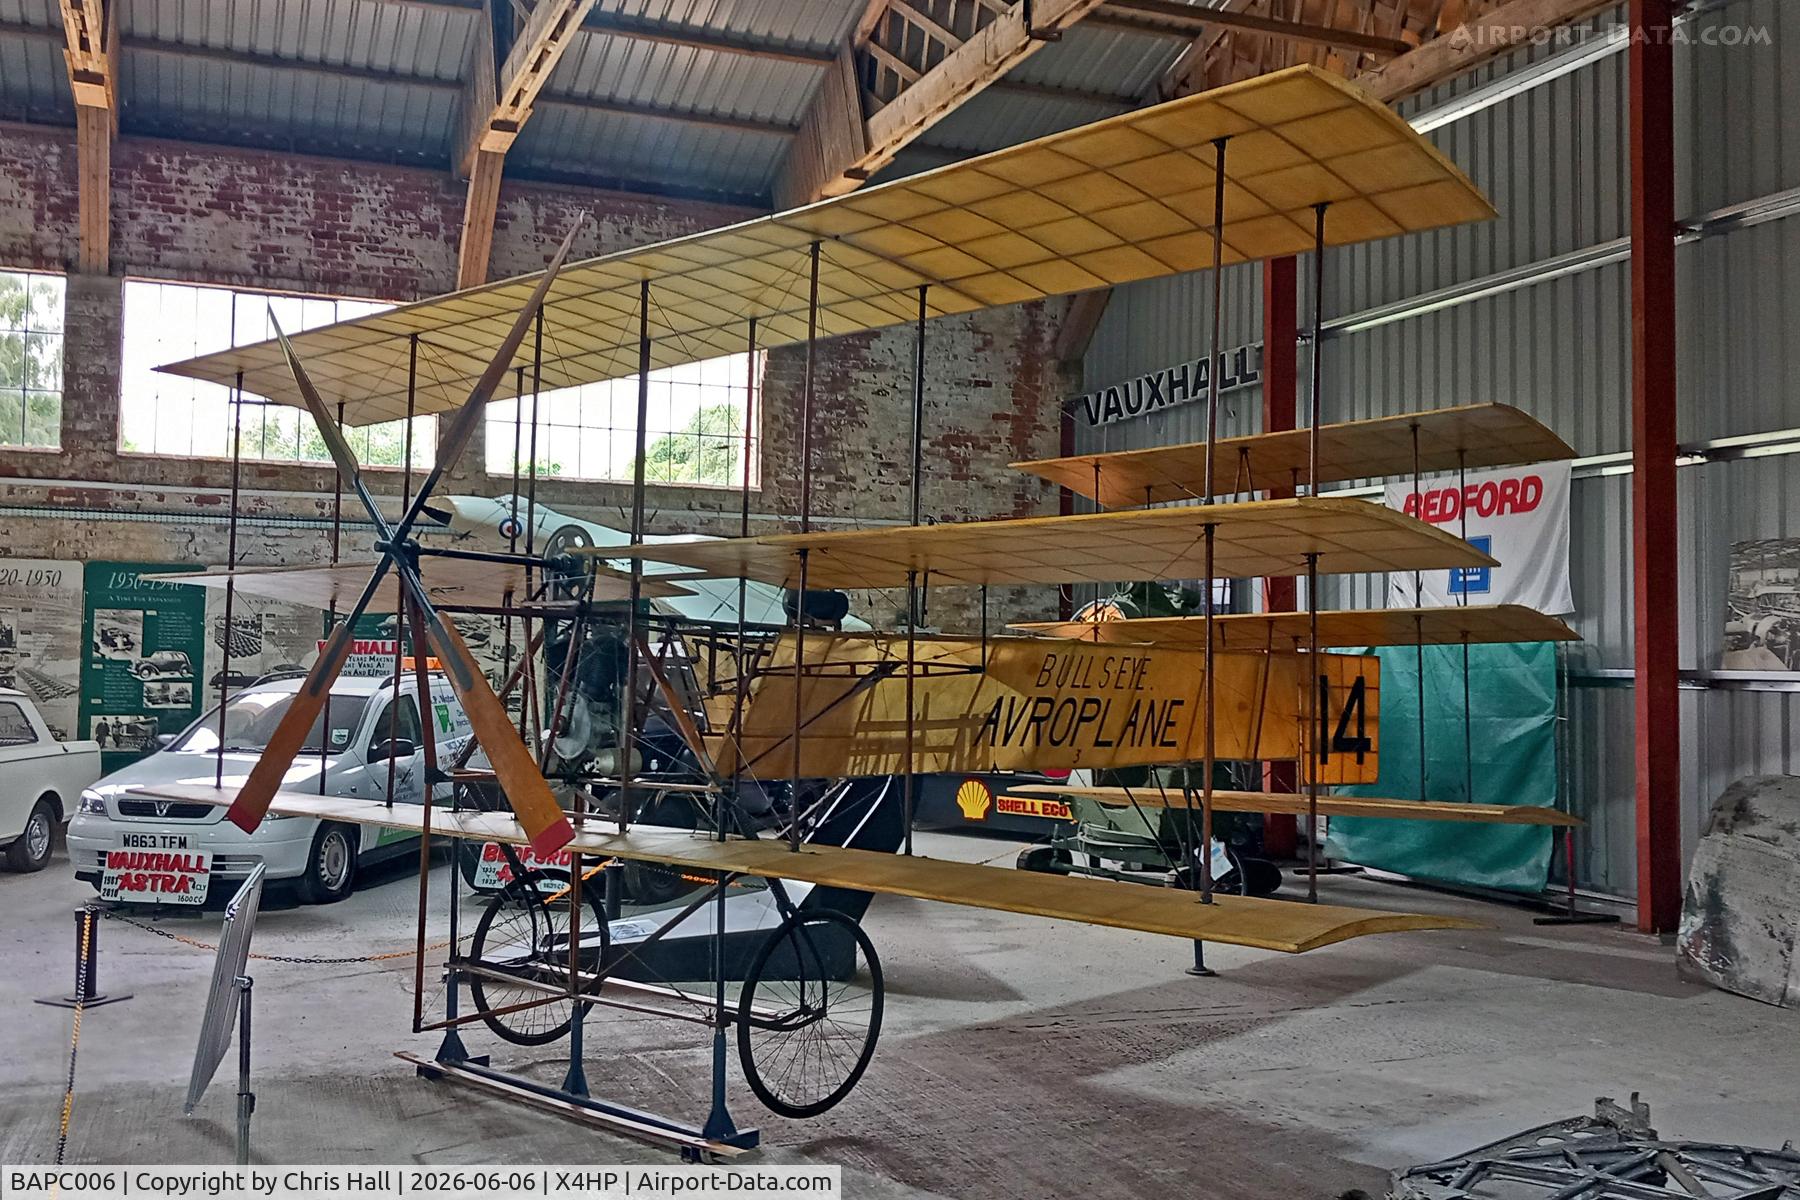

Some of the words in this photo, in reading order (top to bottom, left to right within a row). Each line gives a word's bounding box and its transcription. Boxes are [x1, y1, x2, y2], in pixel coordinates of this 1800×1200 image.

[1083, 346, 1258, 426] VAUXHALL
[1403, 475, 1544, 524] BEDFORD
[972, 695, 1185, 748] AVROPLANE
[1319, 674, 1372, 766] 14
[997, 799, 1040, 815] SHELL
[1041, 802, 1068, 817] ECO
[106, 851, 210, 875] VAUXHALL
[122, 833, 157, 849] W863
[159, 835, 188, 850] TFM
